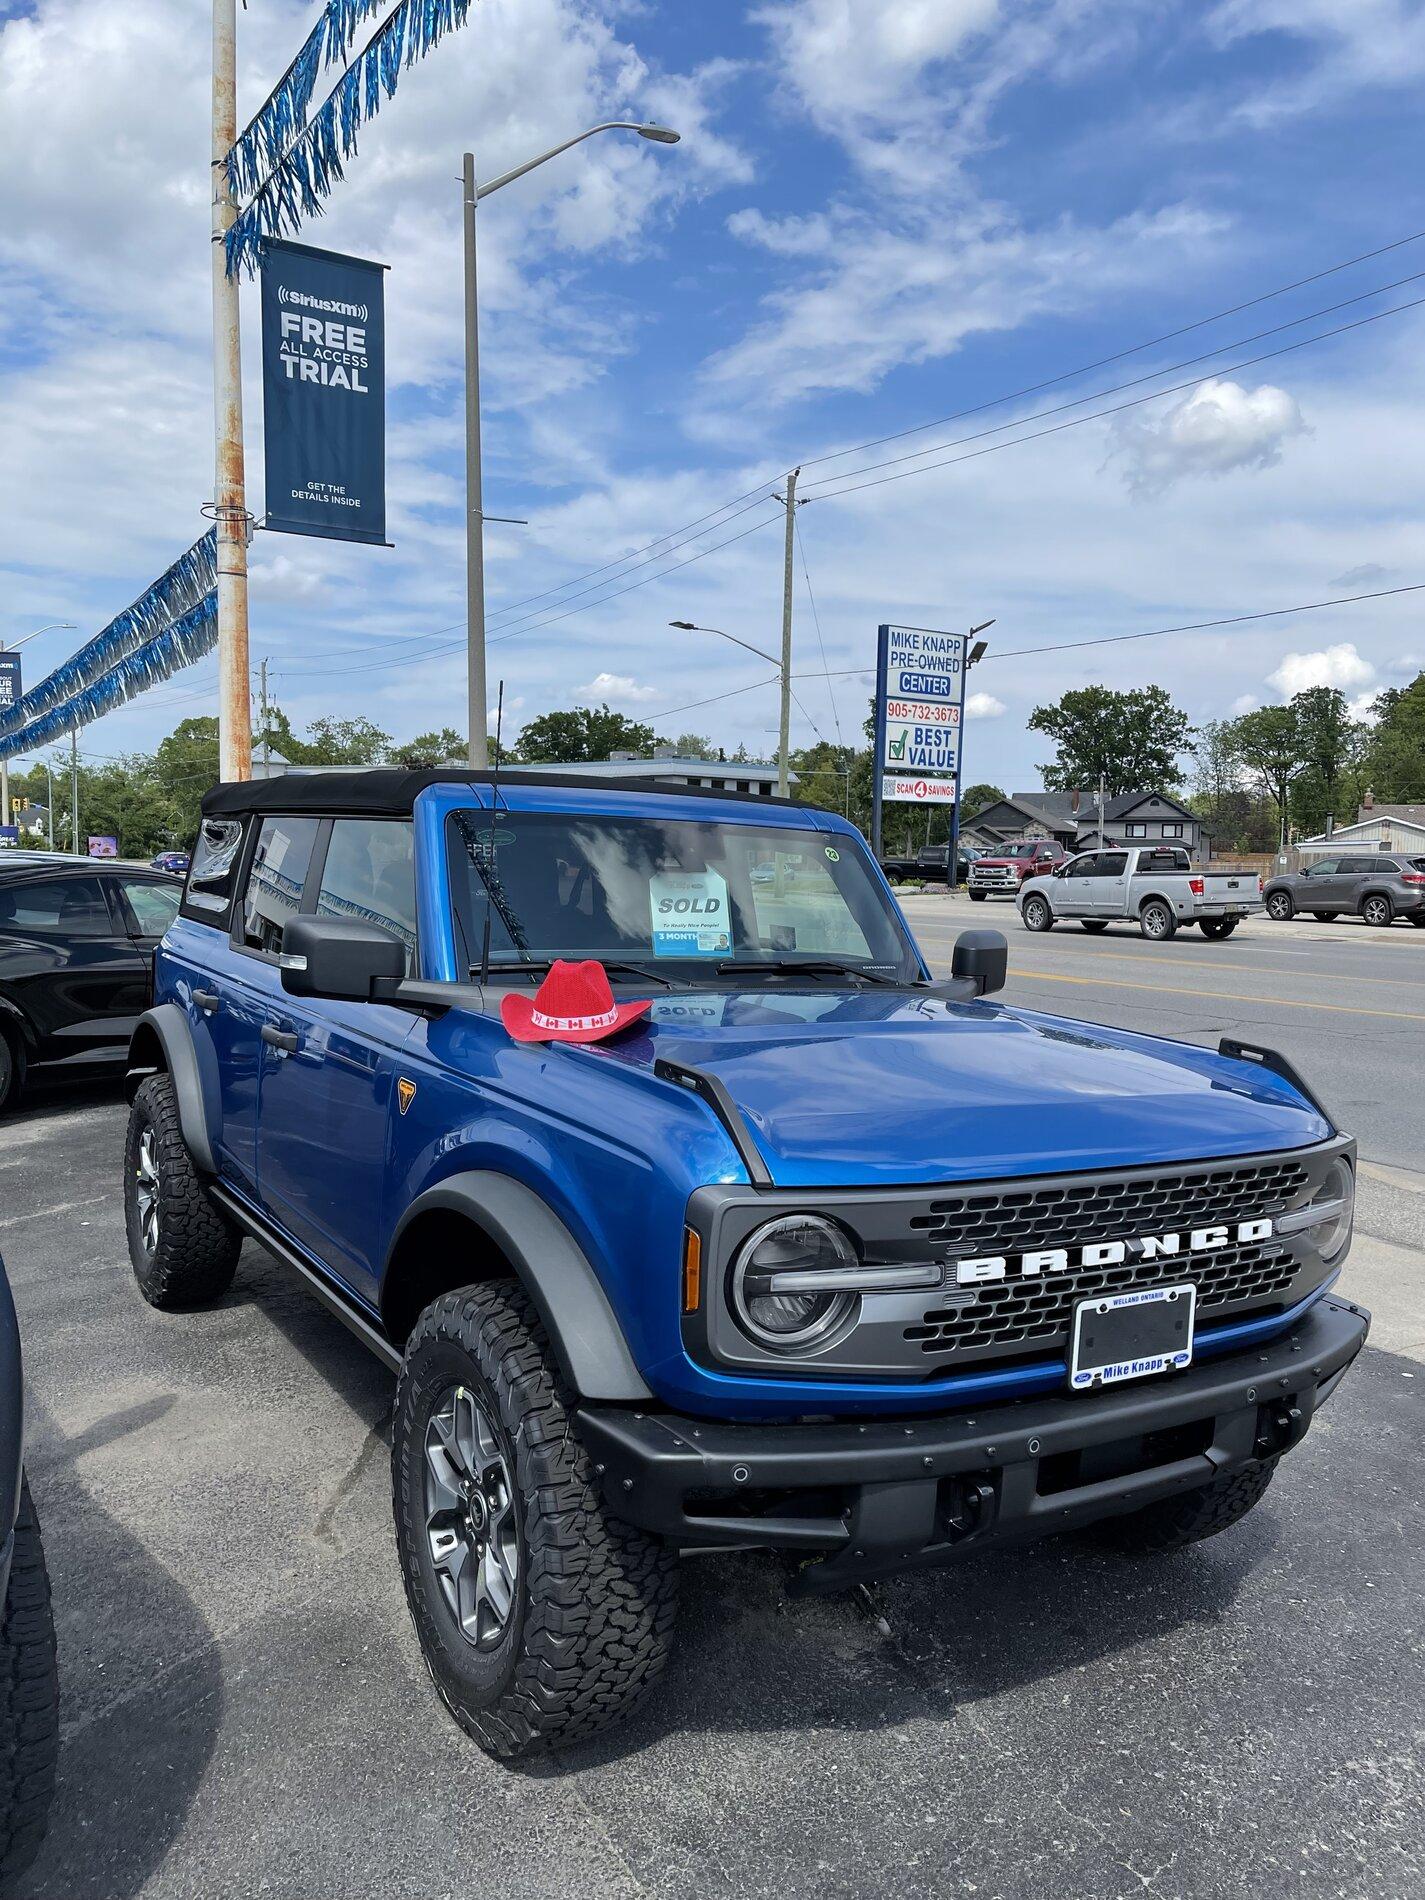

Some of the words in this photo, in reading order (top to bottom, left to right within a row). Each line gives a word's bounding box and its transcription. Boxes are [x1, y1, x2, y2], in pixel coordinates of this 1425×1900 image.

[281, 311, 366, 354] FREE
[280, 340, 307, 356] ALL
[313, 347, 368, 368] ACCESS
[280, 353, 368, 393] TRIAL
[291, 489, 329, 503] DETAILS
[331, 495, 361, 507] INSIDE
[307, 481, 326, 491] GET
[327, 484, 346, 494] THE
[891, 631, 920, 650] MIKE
[922, 635, 961, 654] KNAPP
[890, 651, 960, 673] PRE-OWNED
[901, 674, 948, 694] CENTER
[888, 702, 959, 723] 905-732-3673
[914, 727, 952, 748] BEST
[908, 747, 955, 768] VALUE
[896, 783, 914, 794] SCAN
[915, 782, 926, 797] 4
[928, 785, 955, 796] SAVINGS
[658, 897, 721, 914] SOLD
[658, 932, 665, 940] 3
[956, 1218, 1273, 1284] BRONCO
[1113, 1296, 1139, 1306] WELLAND
[1140, 1292, 1164, 1302] ONTARIO
[1103, 1365, 1129, 1379] Mike
[1131, 1359, 1163, 1373] Knapp
